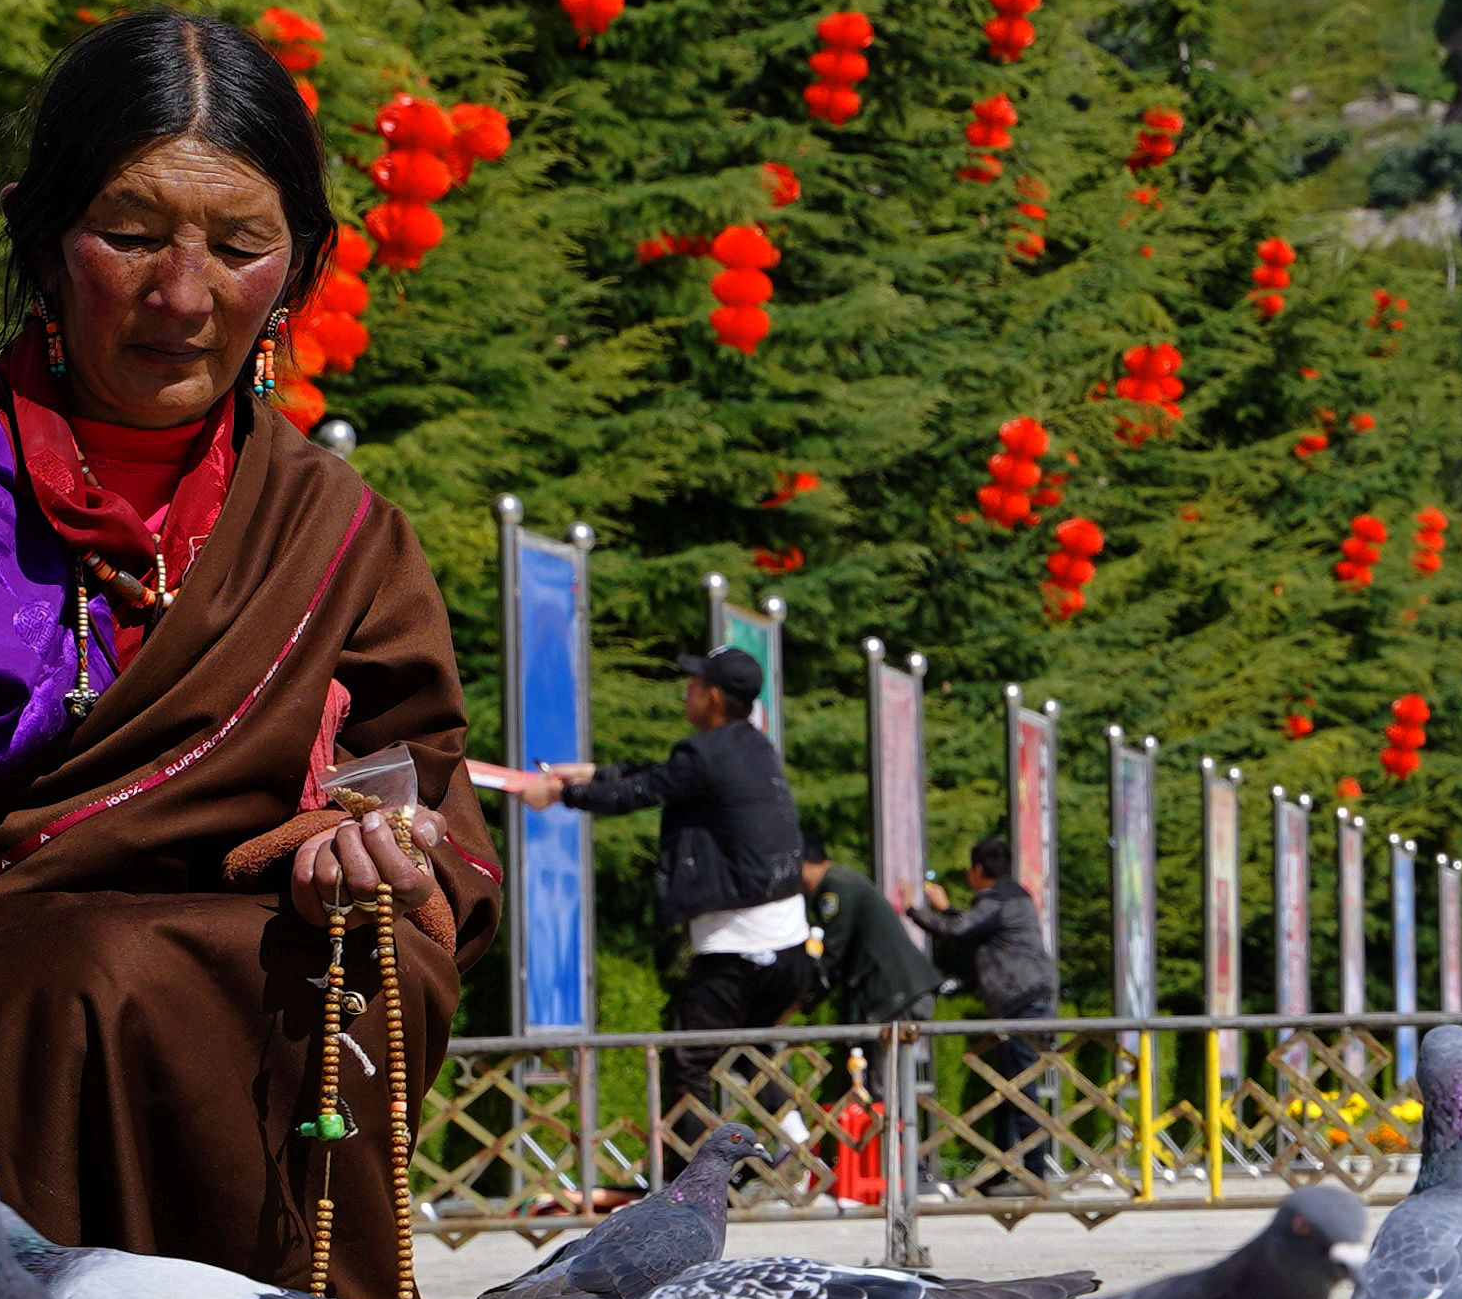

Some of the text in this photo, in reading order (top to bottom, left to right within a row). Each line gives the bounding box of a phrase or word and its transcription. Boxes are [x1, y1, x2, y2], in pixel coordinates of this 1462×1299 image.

[40, 833, 50, 843] A
[105, 786, 143, 807] 100%
[165, 714, 238, 777] SUPERFINE
